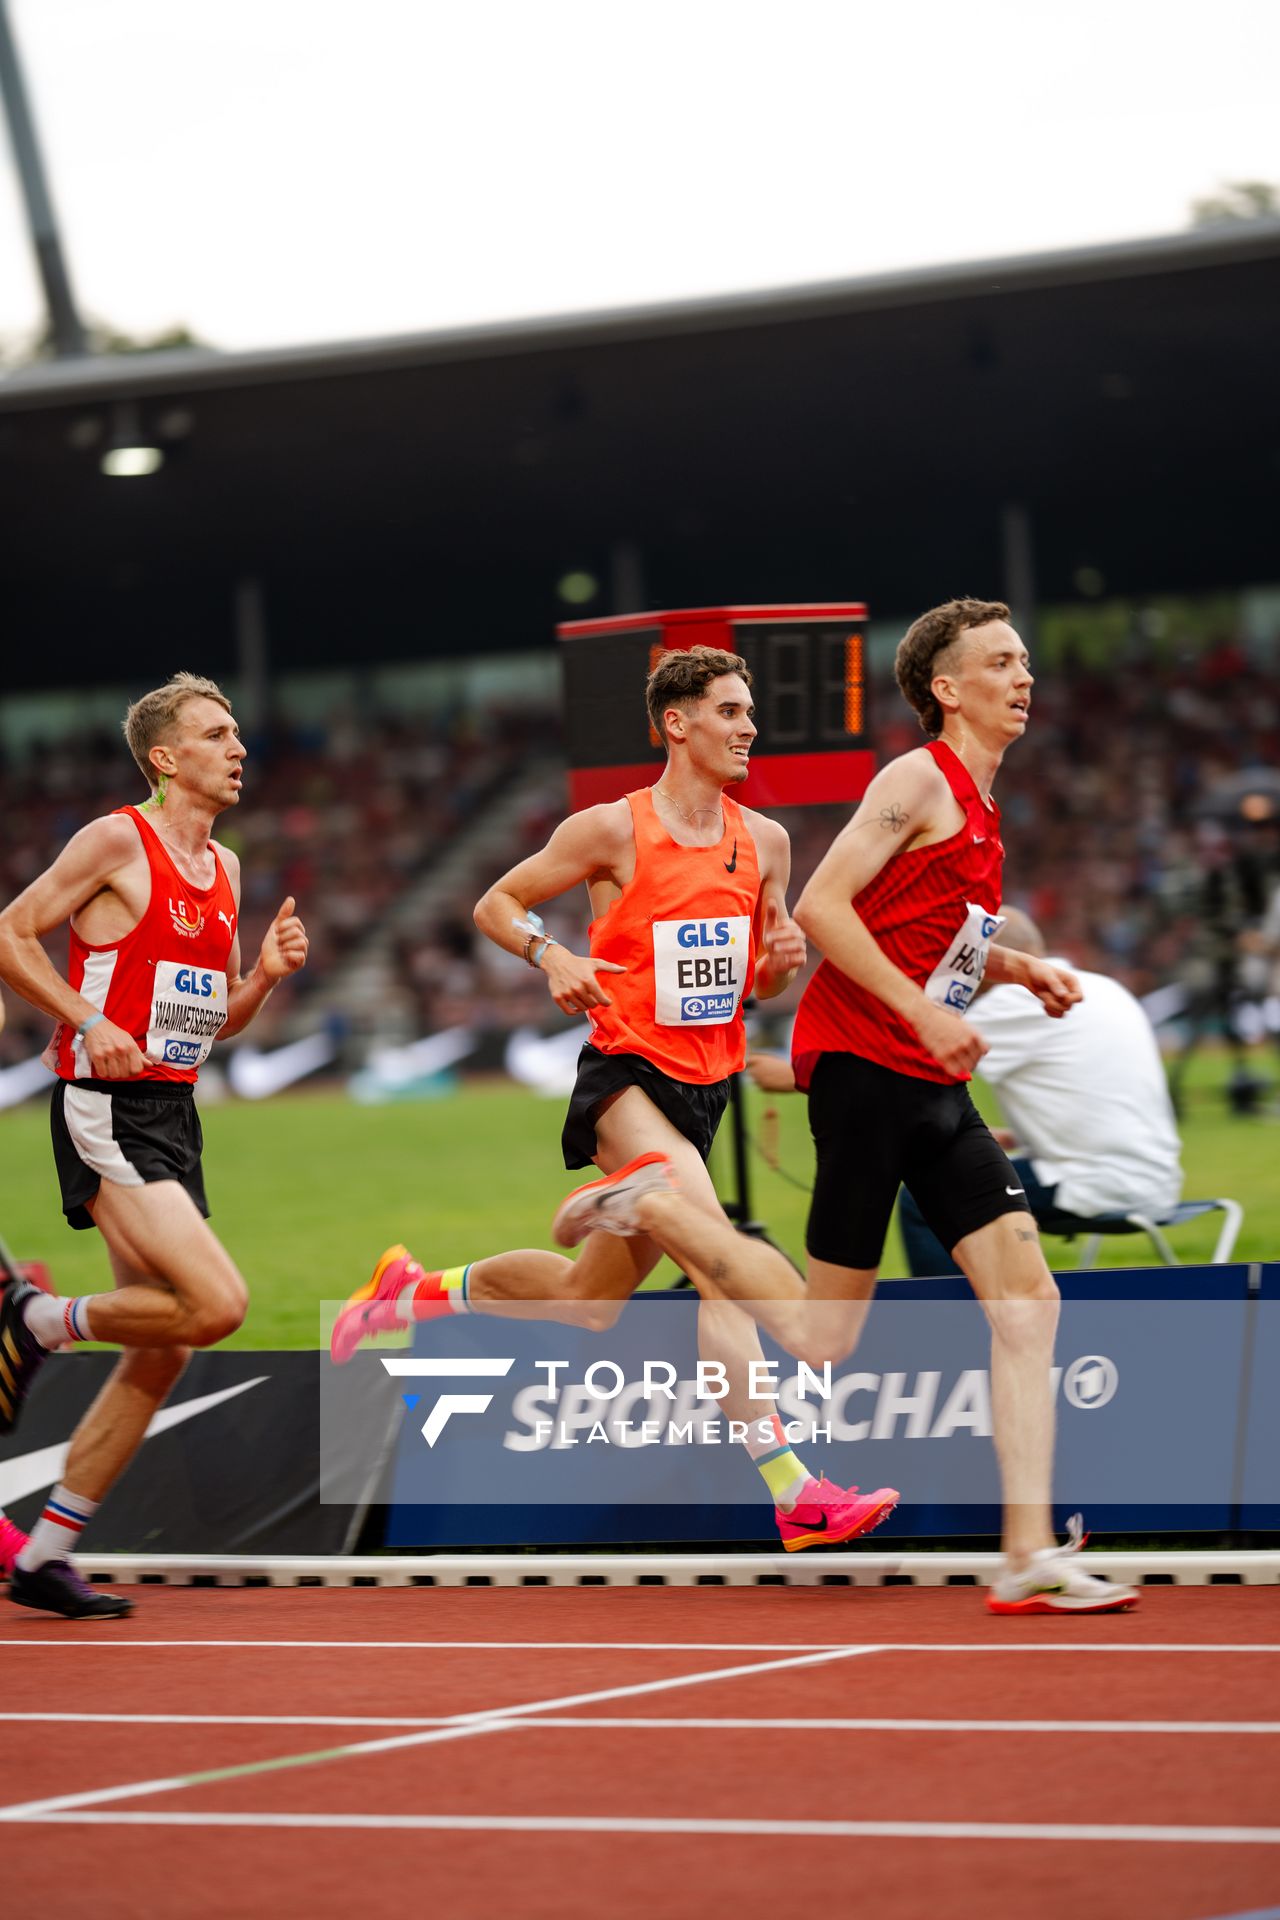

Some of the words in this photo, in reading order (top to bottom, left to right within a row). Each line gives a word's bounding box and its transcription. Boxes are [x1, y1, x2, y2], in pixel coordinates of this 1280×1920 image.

[677, 956, 737, 989] EBEL
[707, 997, 732, 1010] PLAN
[180, 1045, 200, 1058] PLAN
[503, 1366, 1064, 1452] SPORSCHA
